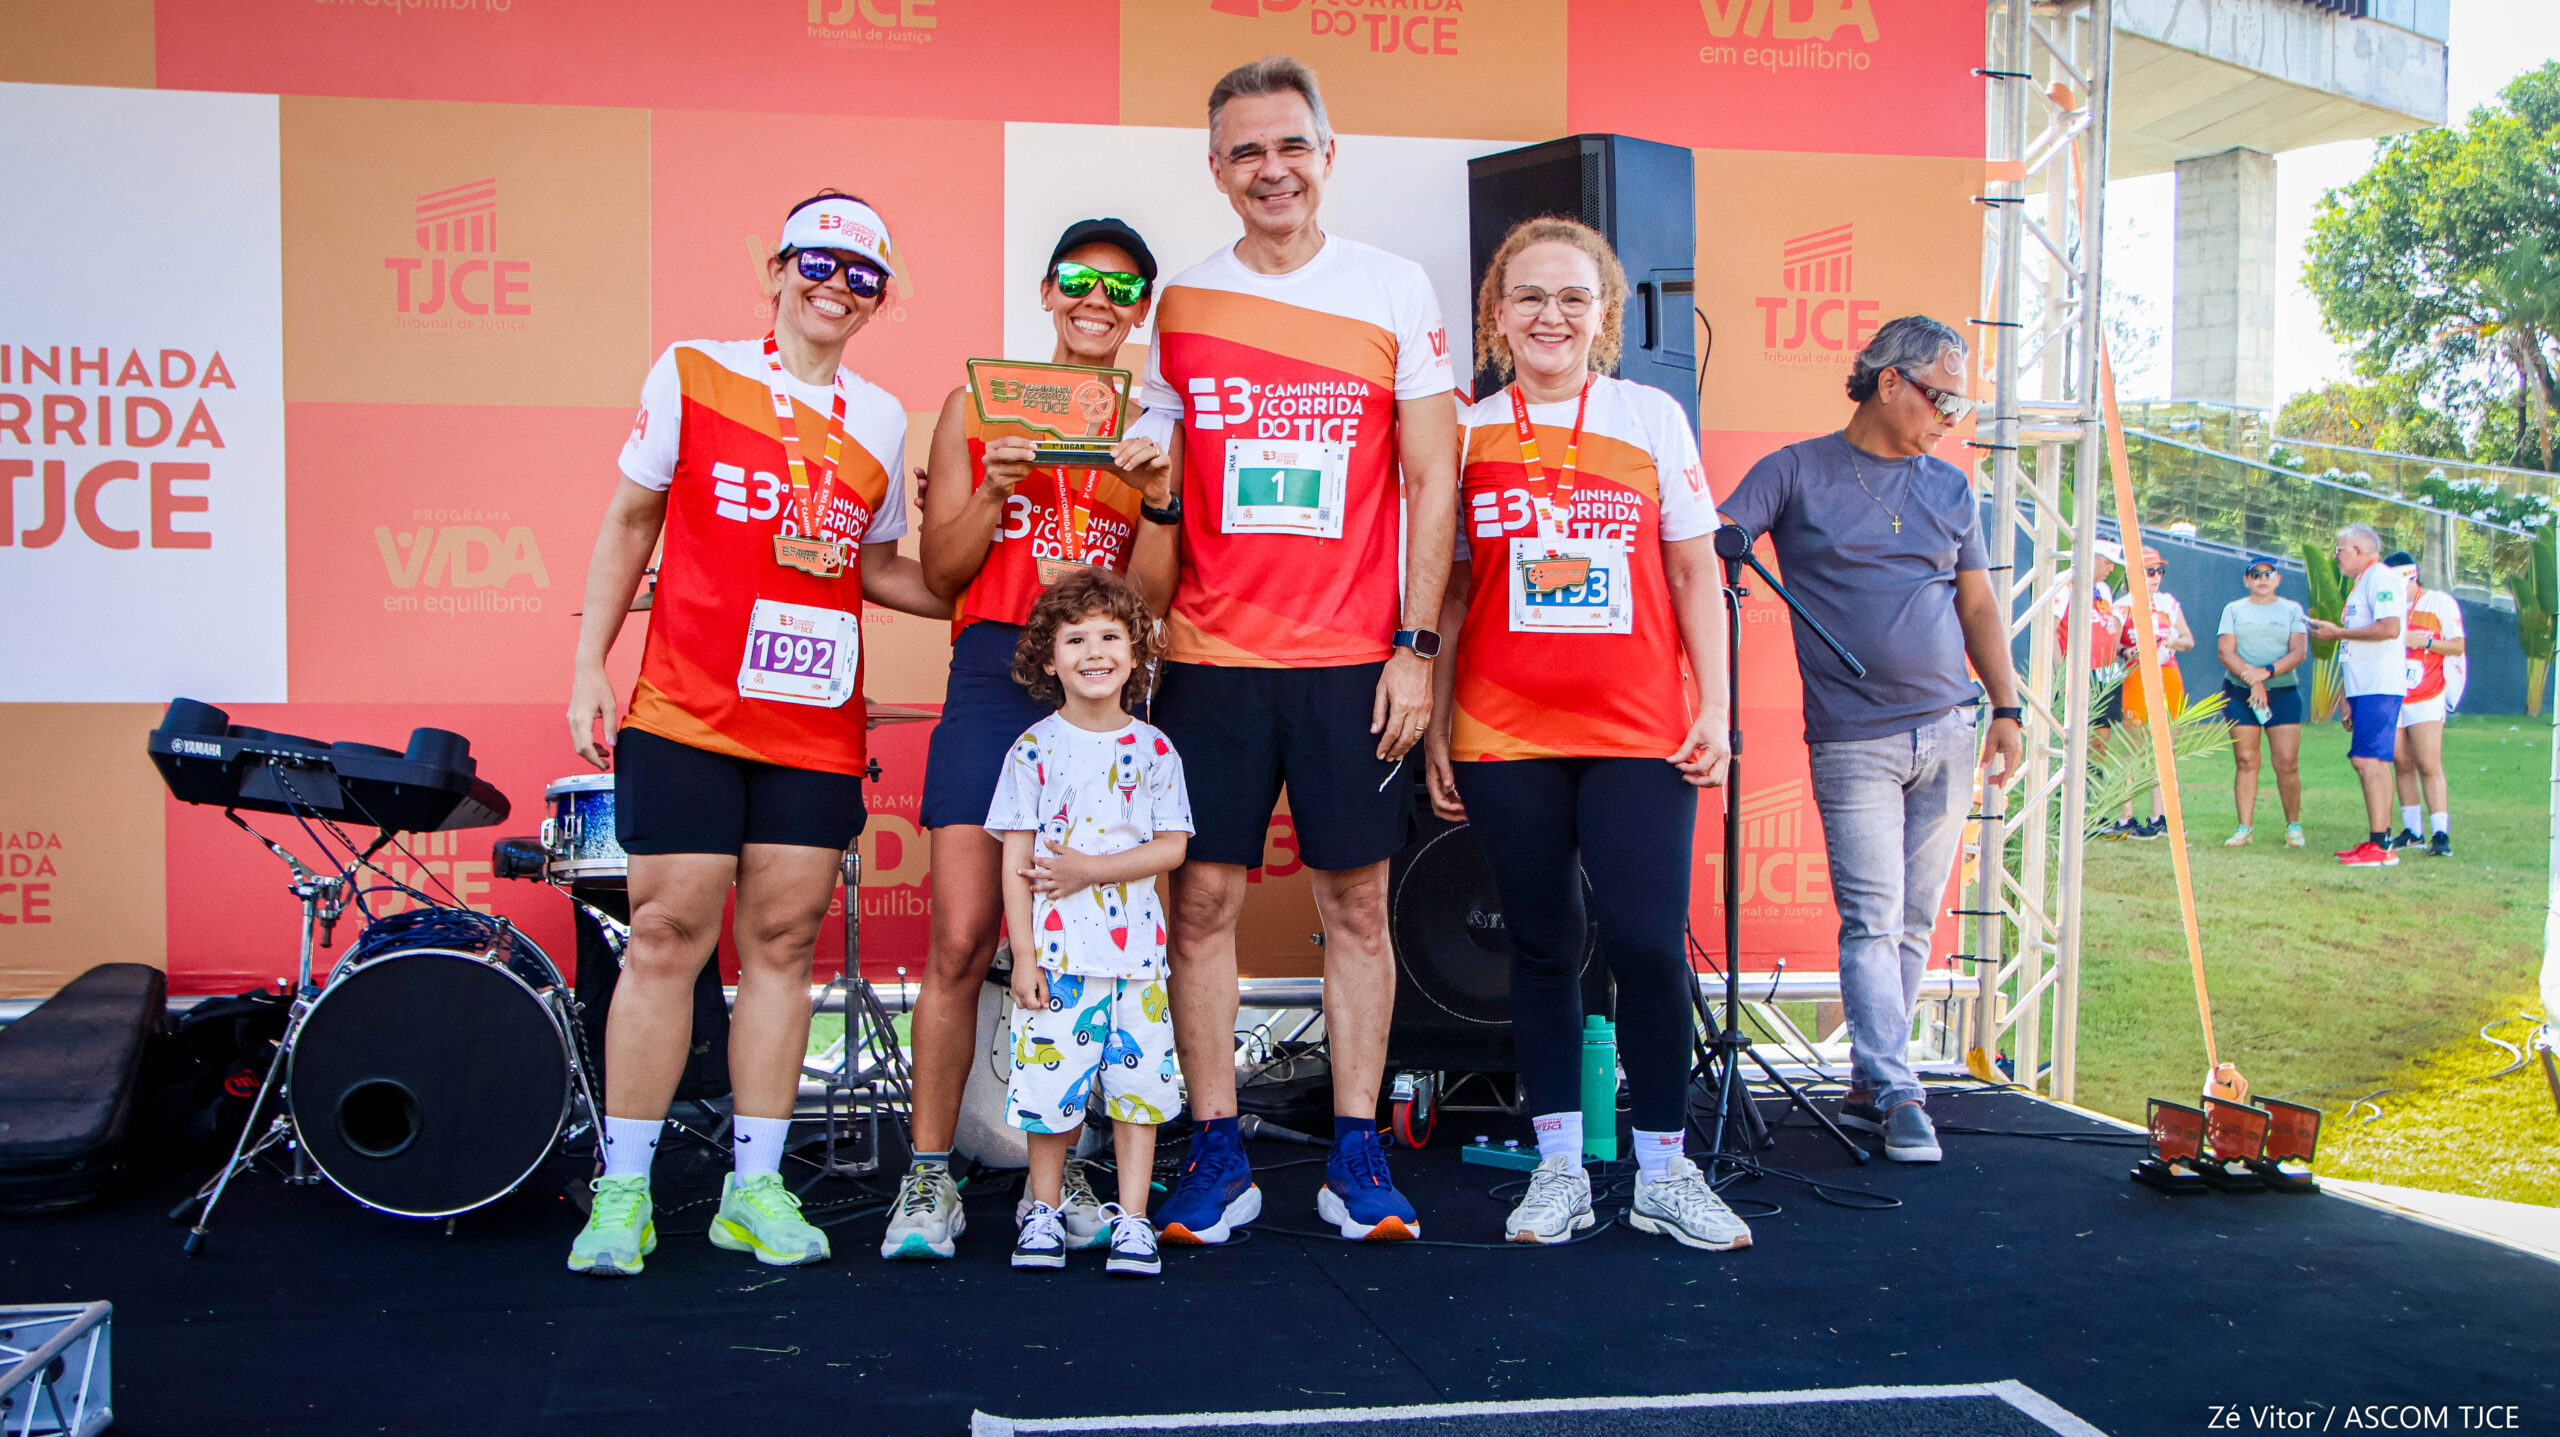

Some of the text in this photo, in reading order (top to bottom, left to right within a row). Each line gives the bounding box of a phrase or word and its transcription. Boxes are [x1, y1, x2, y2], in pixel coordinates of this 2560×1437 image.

[1311, 9, 1458, 55] DO TJCE
[1700, 43, 1870, 74] em equilíbrio
[854, 232, 874, 250] TJCE
[384, 258, 531, 316] TJCE
[1755, 296, 1880, 351] TJCE
[0, 344, 237, 389] INHADA
[1763, 352, 1812, 364] Tribunal
[1264, 382, 1369, 398] CAMINHADA
[0, 393, 226, 448] RRIDA
[1022, 399, 1069, 414] DO TJCE
[1257, 398, 1364, 417] /CORRIDA
[1257, 418, 1290, 438] DO
[1057, 468, 1071, 532] INHADA/CORRIDA
[1271, 470, 1285, 503] 1
[413, 509, 511, 522] PROGRAMA
[1503, 488, 1534, 532] 3
[374, 526, 550, 589] VIDA
[1031, 538, 1062, 560] DO
[384, 590, 542, 618] em equilíbrio
[862, 612, 894, 625] stiça
[1747, 608, 1776, 624] em
[755, 633, 833, 676] 1992
[183, 740, 222, 758] YAMAHA
[1265, 814, 1304, 877] 3
[1705, 852, 1829, 904] TJCE
[1783, 906, 1823, 919] Justiça
